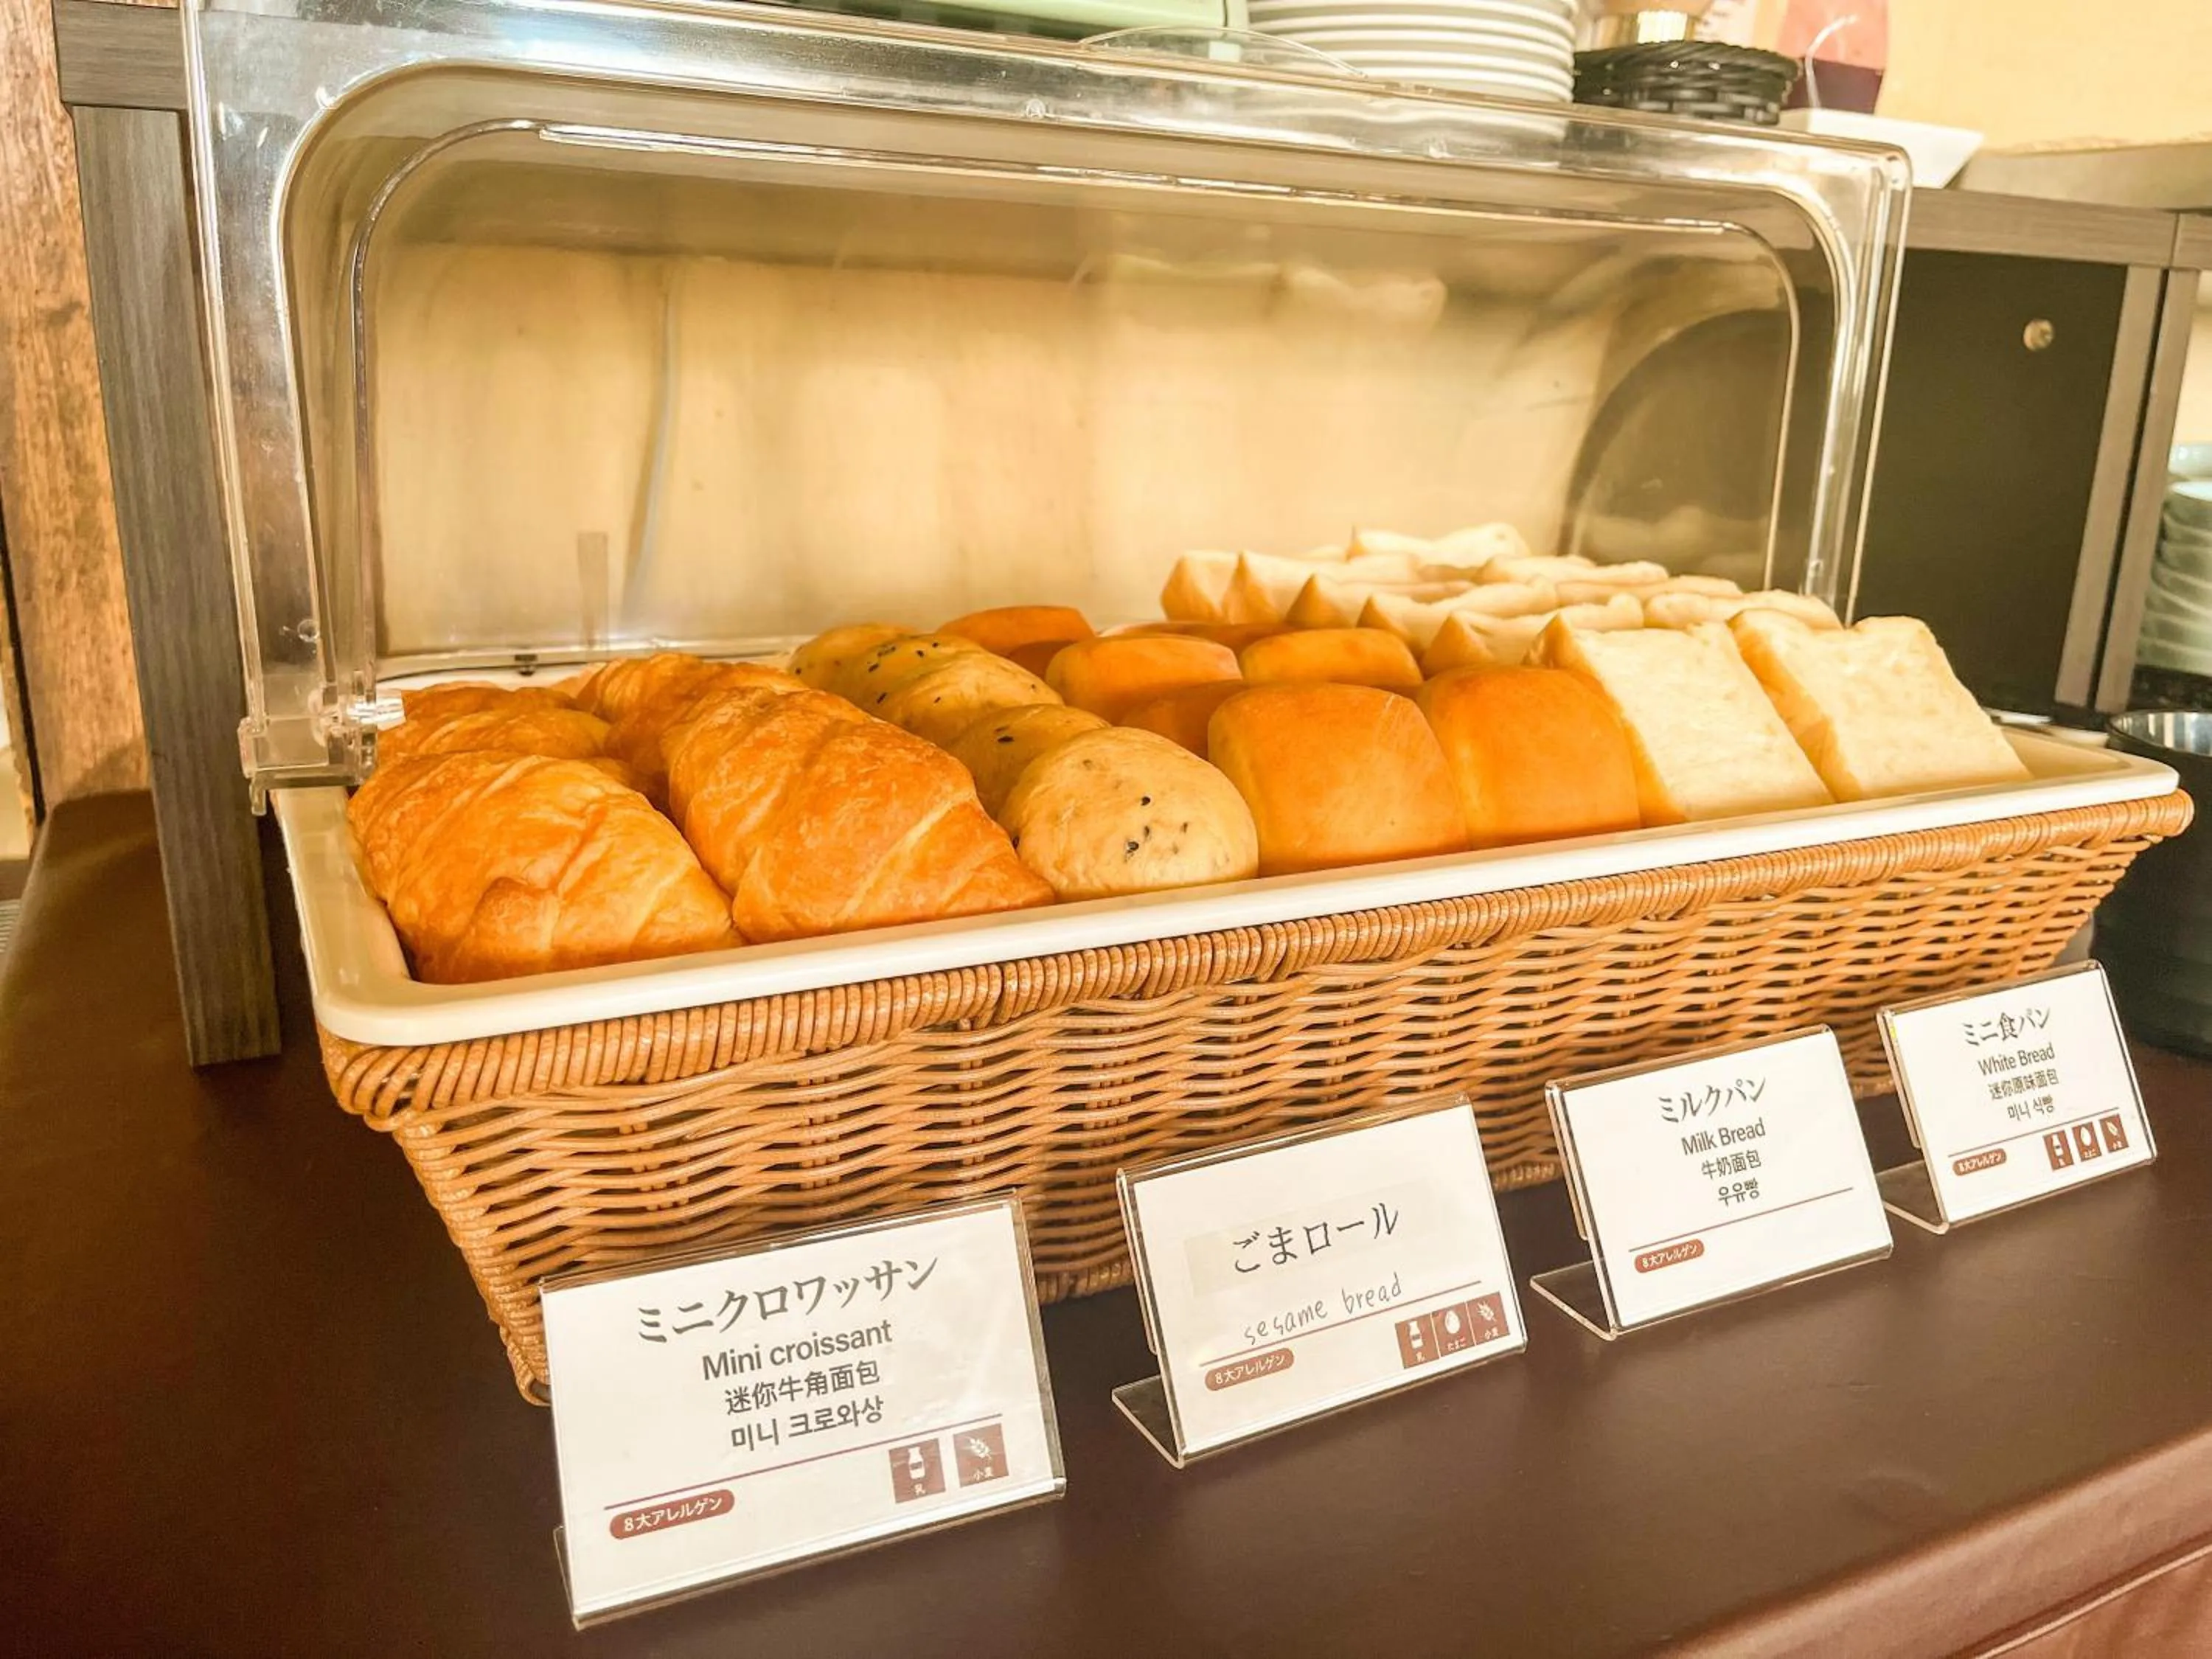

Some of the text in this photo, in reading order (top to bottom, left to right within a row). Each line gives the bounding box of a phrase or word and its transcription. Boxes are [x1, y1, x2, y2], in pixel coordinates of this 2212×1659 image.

[1962, 1007, 2051, 1046] ミニ食パン
[1978, 1043, 2056, 1077] White Bread
[1658, 1077, 1767, 1124] ミルクパン
[2007, 1093, 2055, 1121] 미니 식빵
[1681, 1117, 1766, 1156] Milk Bread
[1701, 1149, 1761, 1180] 牛奶面包
[1718, 1178, 1760, 1207] 우유빵
[1233, 1202, 1399, 1274] ごまロール
[1642, 1244, 1697, 1269] 8大アレルゲン
[637, 1256, 939, 1343] ミニクロワッサン
[1244, 1273, 1402, 1346] sesame bread
[702, 1320, 893, 1381] Mini croissant
[1214, 1354, 1285, 1385] 8大アレルゲン
[725, 1360, 881, 1415] 迷你牛角面包
[731, 1395, 885, 1452] 미니 크로와상
[624, 1497, 723, 1532] 8大アレルゲン
